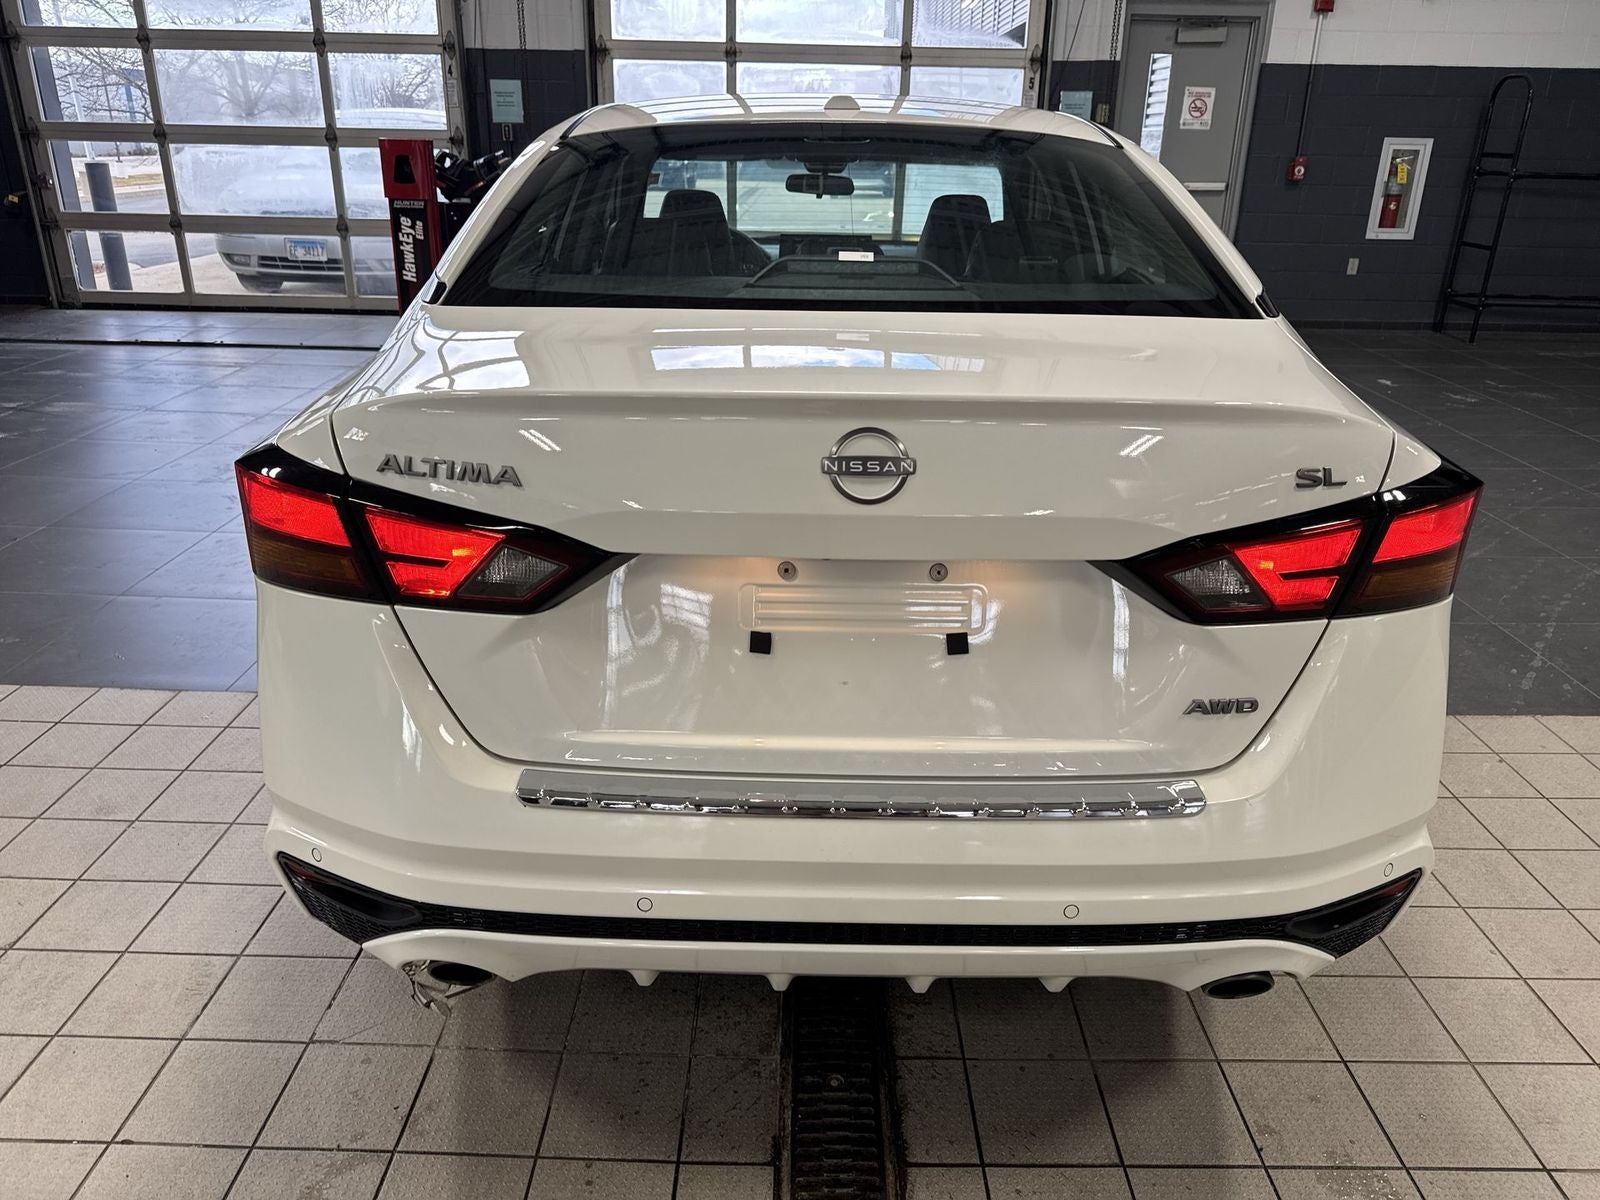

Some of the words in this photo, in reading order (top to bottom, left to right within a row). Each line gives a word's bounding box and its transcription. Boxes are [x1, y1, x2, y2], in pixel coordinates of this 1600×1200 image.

[447, 64, 454, 77] 4
[1028, 76, 1036, 90] 5
[415, 220, 425, 241] Elite
[398, 215, 418, 283] HawkEye
[376, 453, 523, 488] ALTIMA
[823, 460, 914, 472] NISSAN
[1295, 466, 1348, 489] SL
[1182, 697, 1259, 715] AWD
